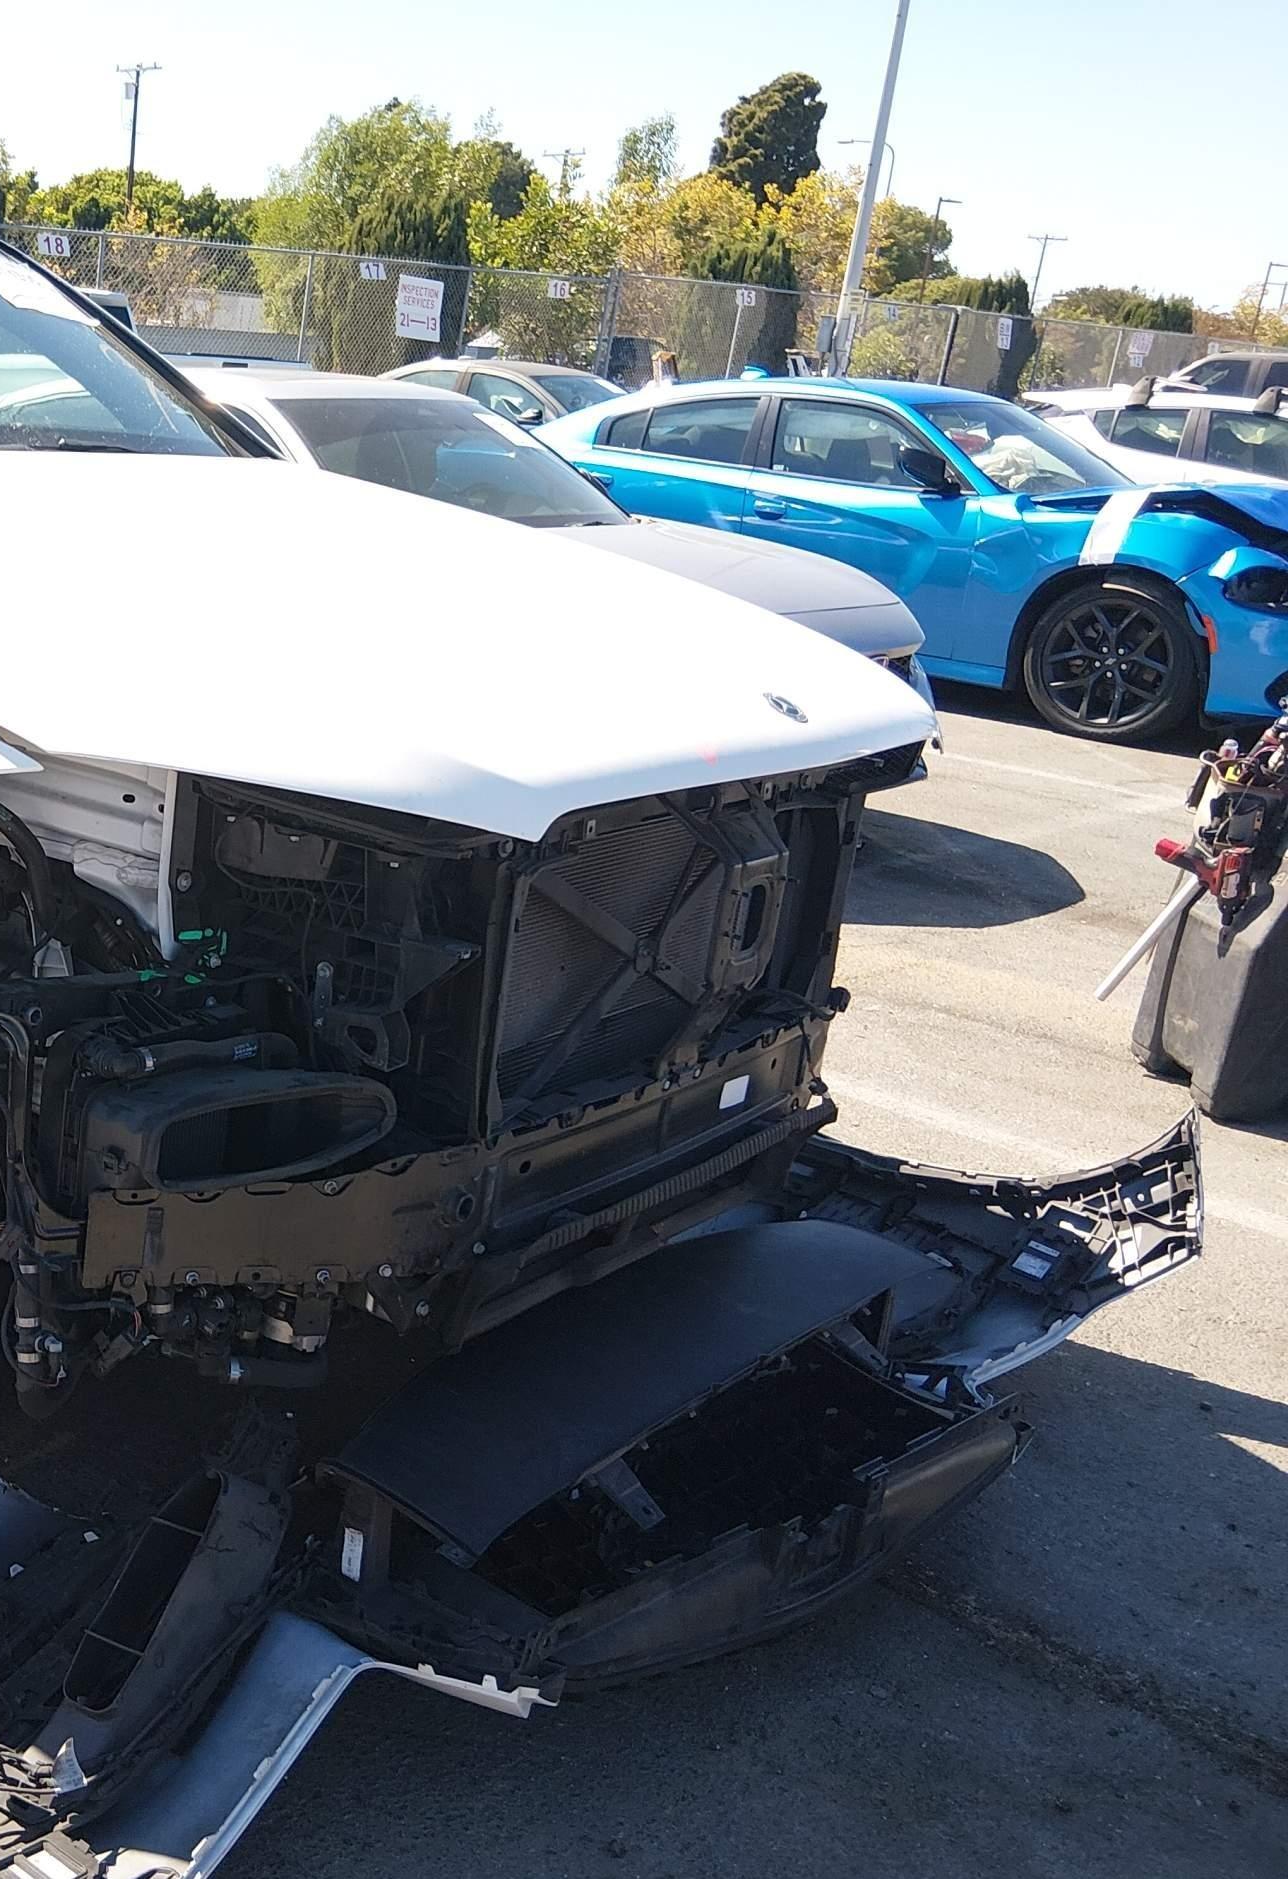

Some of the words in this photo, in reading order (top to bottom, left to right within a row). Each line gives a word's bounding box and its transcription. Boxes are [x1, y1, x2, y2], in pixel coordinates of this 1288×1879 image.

[43, 236, 65, 255] 18
[365, 263, 380, 281] 17
[401, 283, 440, 299] INSPECTION
[552, 282, 567, 298] 16
[740, 290, 753, 305] 15
[403, 295, 436, 310] SERVICES
